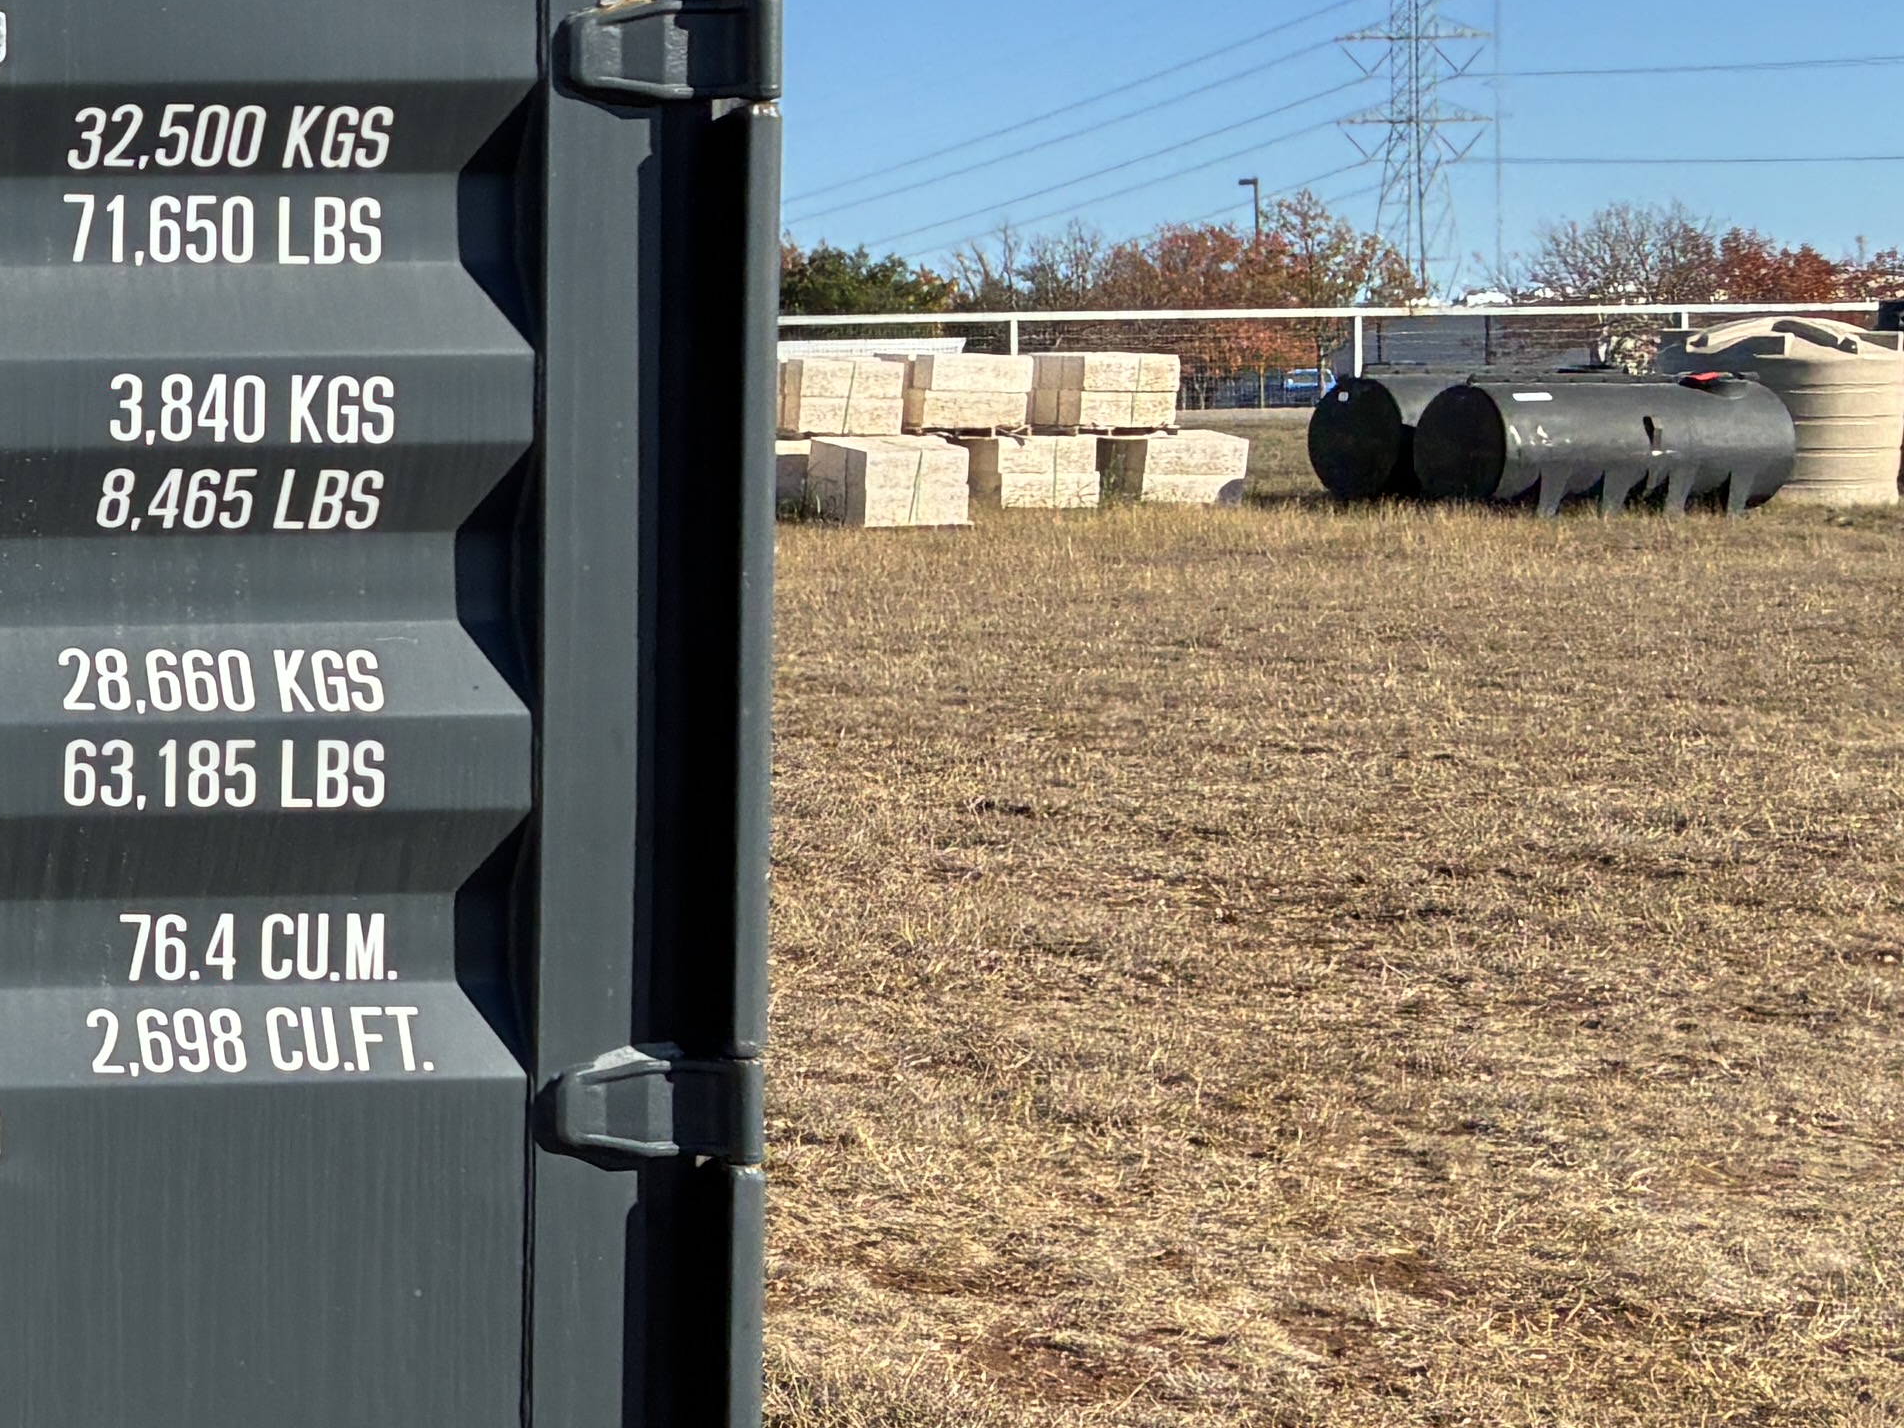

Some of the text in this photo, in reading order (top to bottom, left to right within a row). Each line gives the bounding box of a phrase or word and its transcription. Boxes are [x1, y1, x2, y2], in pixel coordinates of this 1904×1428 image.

[67, 103, 394, 170] 32,500 KGS
[63, 193, 382, 267] 71,650 LBS
[109, 373, 395, 446] 3,840 KGS
[96, 468, 384, 532] 8,465 LBS
[57, 647, 385, 715] 28,660 KGS
[63, 738, 385, 811] 63,185 LBS
[119, 912, 398, 982] 76.4 CU.M.
[85, 1004, 434, 1078] 2,698 CU.FT.
